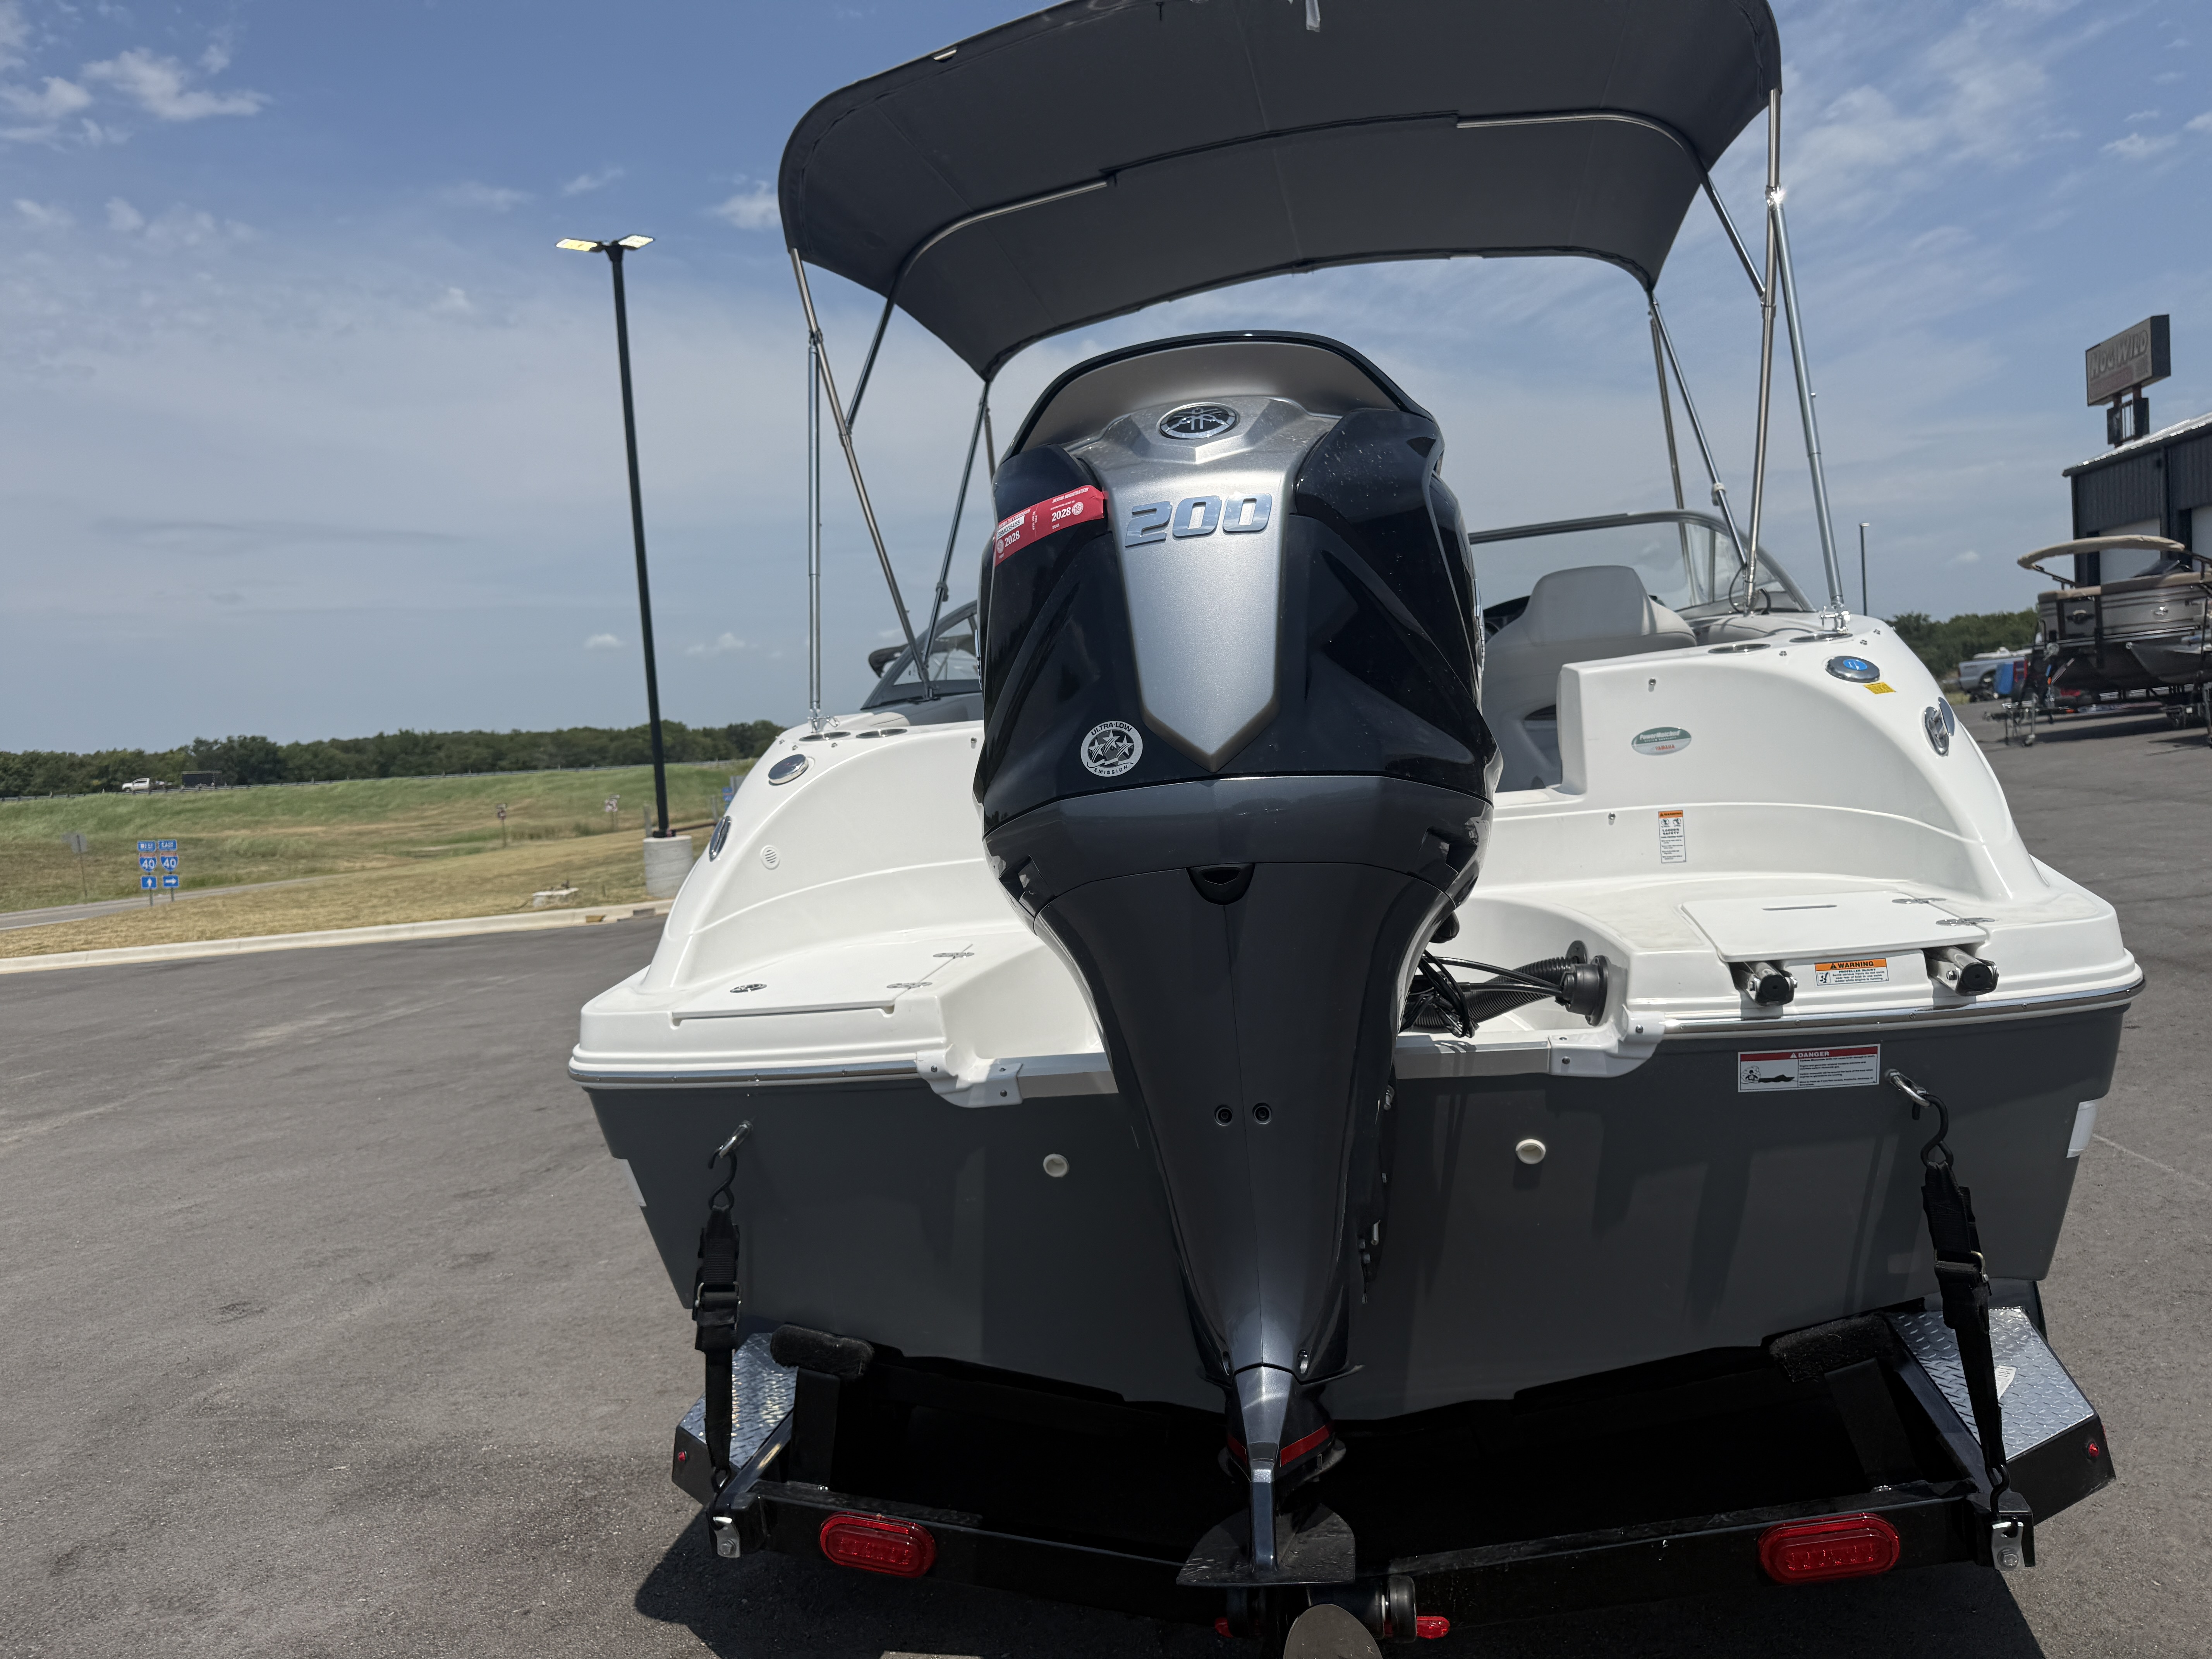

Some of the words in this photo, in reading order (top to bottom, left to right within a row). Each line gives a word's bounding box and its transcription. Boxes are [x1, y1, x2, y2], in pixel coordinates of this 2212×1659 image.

[1051, 507, 1071, 522] 2028
[1125, 493, 1272, 548] 200
[1004, 530, 1020, 547] 2028
[1091, 722, 1113, 735] ULTRA
[1115, 722, 1132, 732] LOW
[1094, 764, 1128, 774] EMISSION
[142, 859, 155, 869] 40
[163, 858, 176, 868] 40
